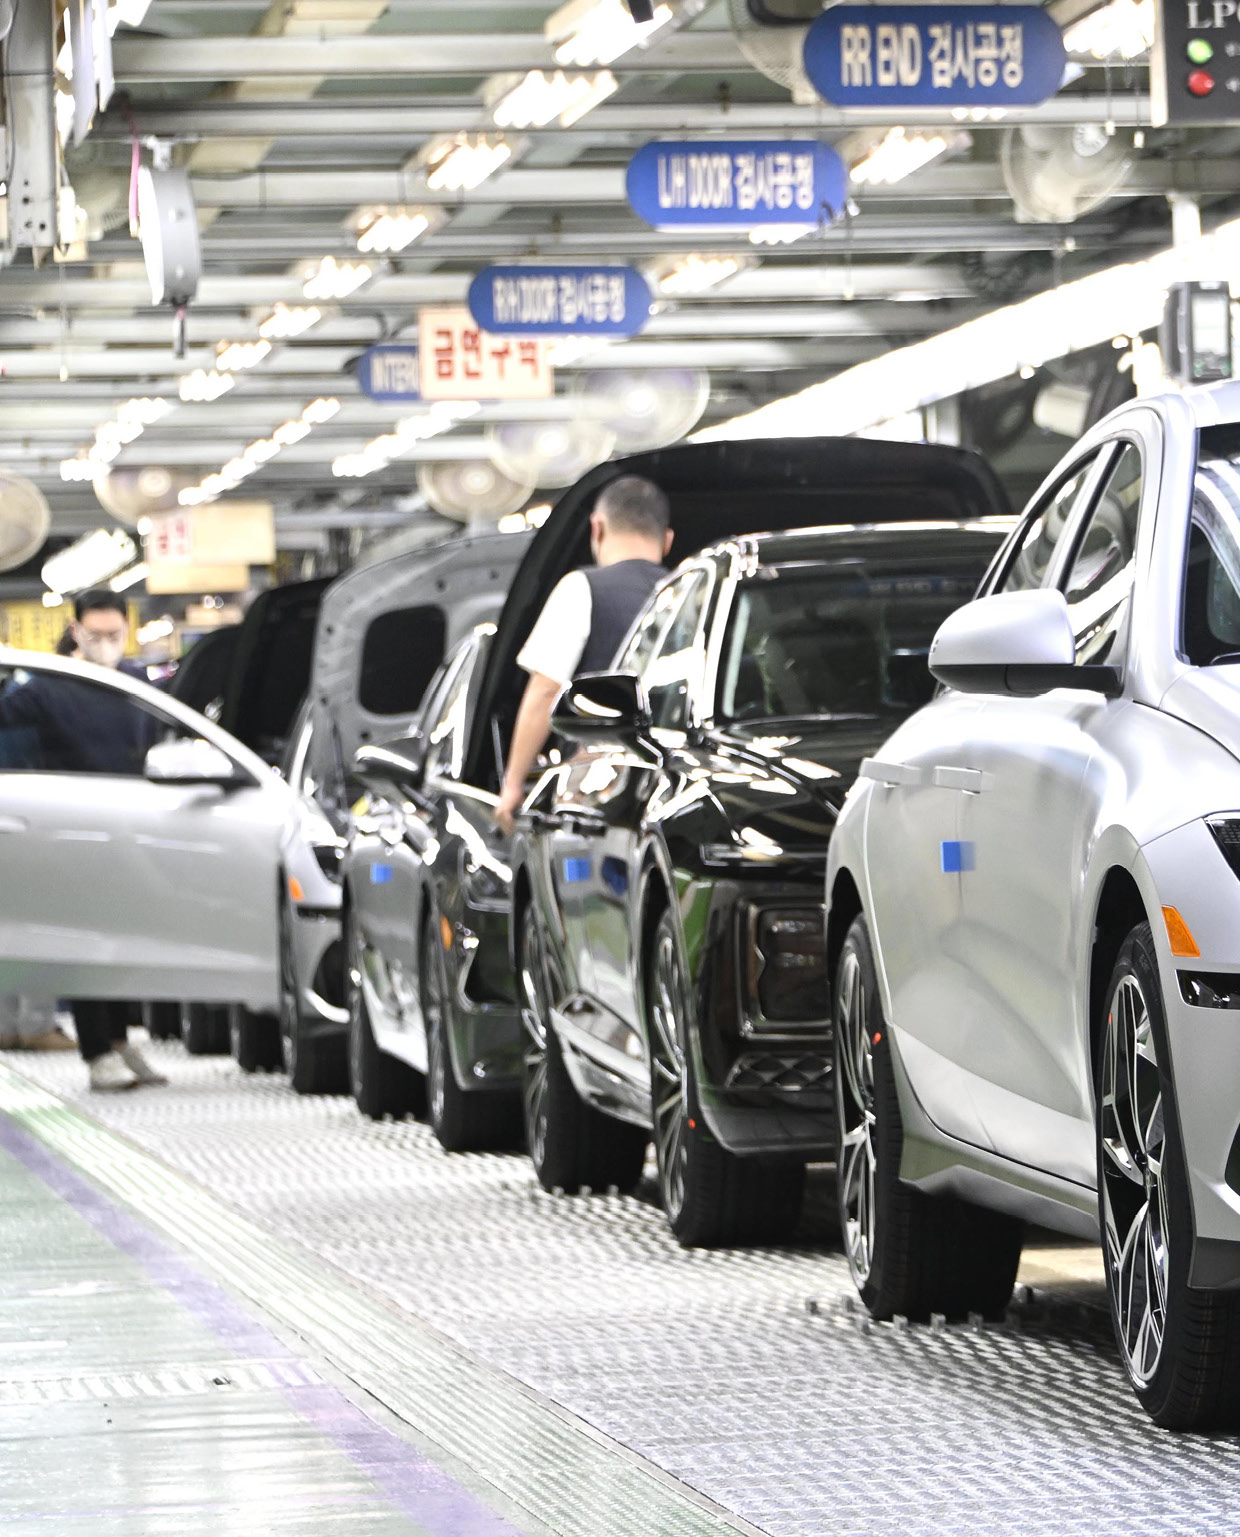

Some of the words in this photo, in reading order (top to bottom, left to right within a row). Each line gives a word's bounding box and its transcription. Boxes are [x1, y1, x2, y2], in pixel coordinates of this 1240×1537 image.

[840, 23, 873, 88] RR
[875, 23, 923, 88] END
[926, 22, 1024, 89] 검사공정
[734, 151, 815, 210] 검사공정
[559, 273, 626, 325] 검사공정
